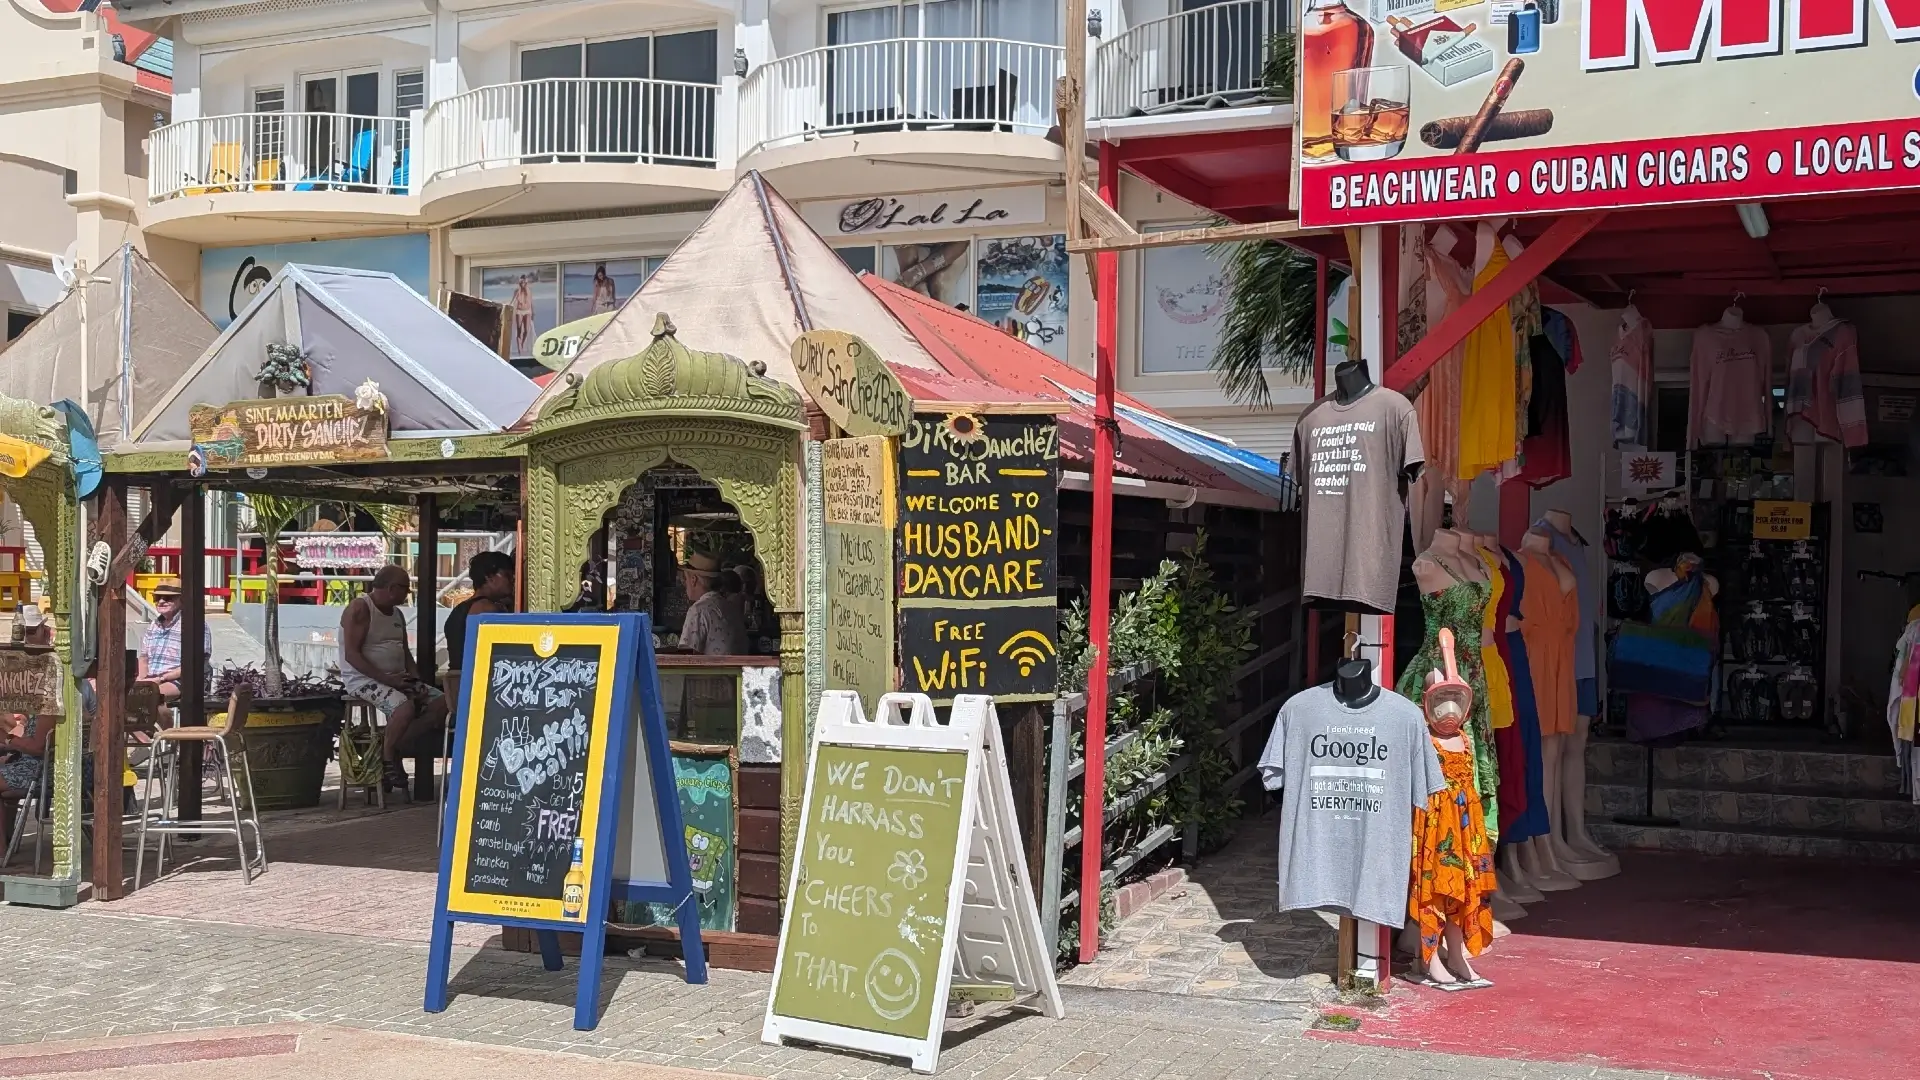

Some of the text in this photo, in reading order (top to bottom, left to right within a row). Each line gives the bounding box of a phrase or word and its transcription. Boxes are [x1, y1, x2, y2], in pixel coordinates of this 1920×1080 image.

[1330, 164, 1497, 209] BEACHWEAR
[1531, 154, 1627, 195] CUBAN
[1637, 144, 1749, 187] CIGARS
[1794, 134, 1893, 176] LOCAL
[952, 198, 1009, 225] La
[541, 329, 597, 357] Dirt
[1176, 345, 1206, 359] THE
[275, 402, 343, 422] MAARTEN
[254, 421, 299, 450] DIRTY
[301, 415, 370, 449] SANCHEZ
[902, 419, 969, 461] DiR
[1320, 423, 1353, 437] parents
[1353, 421, 1376, 432] said
[1316, 433, 1357, 448] I could be
[248, 454, 262, 463] THE
[263, 453, 283, 463] MOST
[1311, 446, 1362, 463] anything,
[945, 462, 991, 486] BAR
[1353, 462, 1367, 472] an
[906, 491, 1040, 514] WELCOME TO
[905, 514, 1052, 559] HUSBAND-
[904, 560, 1044, 598] DAYCARE
[934, 620, 986, 642] FREE
[493, 659, 541, 691] Dirty
[913, 648, 987, 692] WiFi
[545, 687, 578, 708] Bar
[500, 708, 587, 774] Bucket
[1326, 725, 1376, 735] I don't need
[1310, 734, 1388, 766] Google
[552, 772, 584, 794] BUY 5
[827, 761, 963, 800] WE DON'T
[1314, 779, 1326, 794] got
[1333, 779, 1349, 792] wife
[1350, 779, 1364, 793] that
[483, 787, 506, 798] coors
[1310, 796, 1382, 814] EVERYTHING!
[480, 818, 501, 832] carib
[820, 794, 924, 840] HARRASS
[478, 837, 504, 849] amstel
[804, 879, 894, 918] CHEERS
